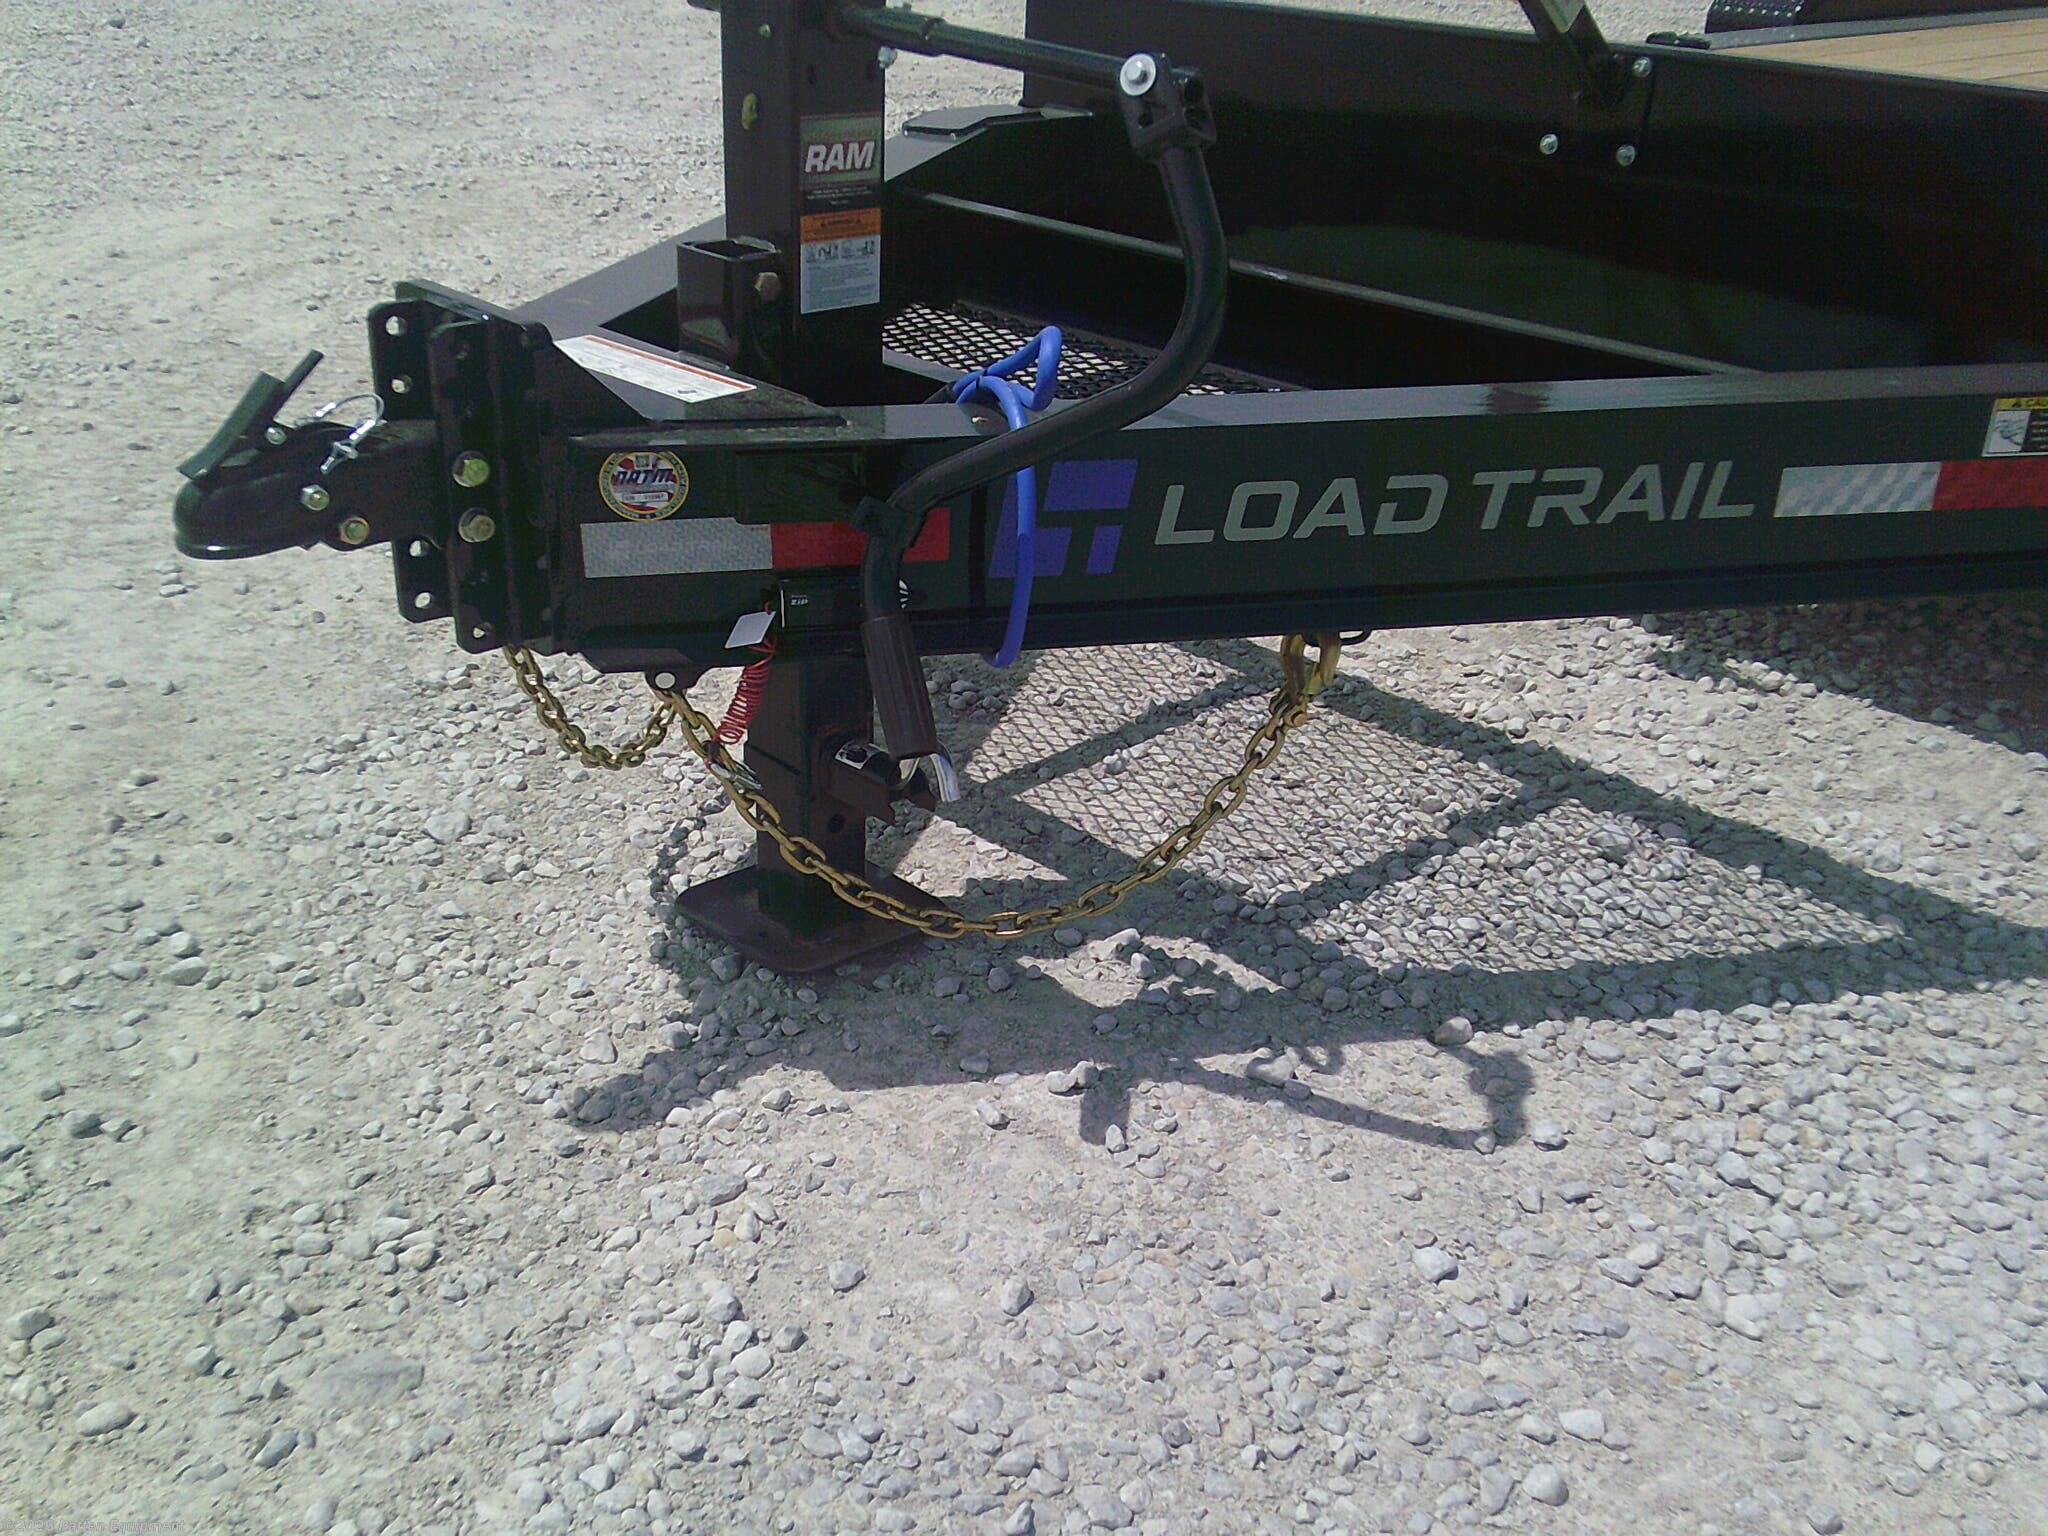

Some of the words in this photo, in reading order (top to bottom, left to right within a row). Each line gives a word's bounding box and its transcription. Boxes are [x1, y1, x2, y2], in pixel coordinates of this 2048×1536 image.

[804, 141, 875, 173] RAM
[1155, 474, 1449, 545] LOAD
[1473, 460, 1755, 530] TRAIL
